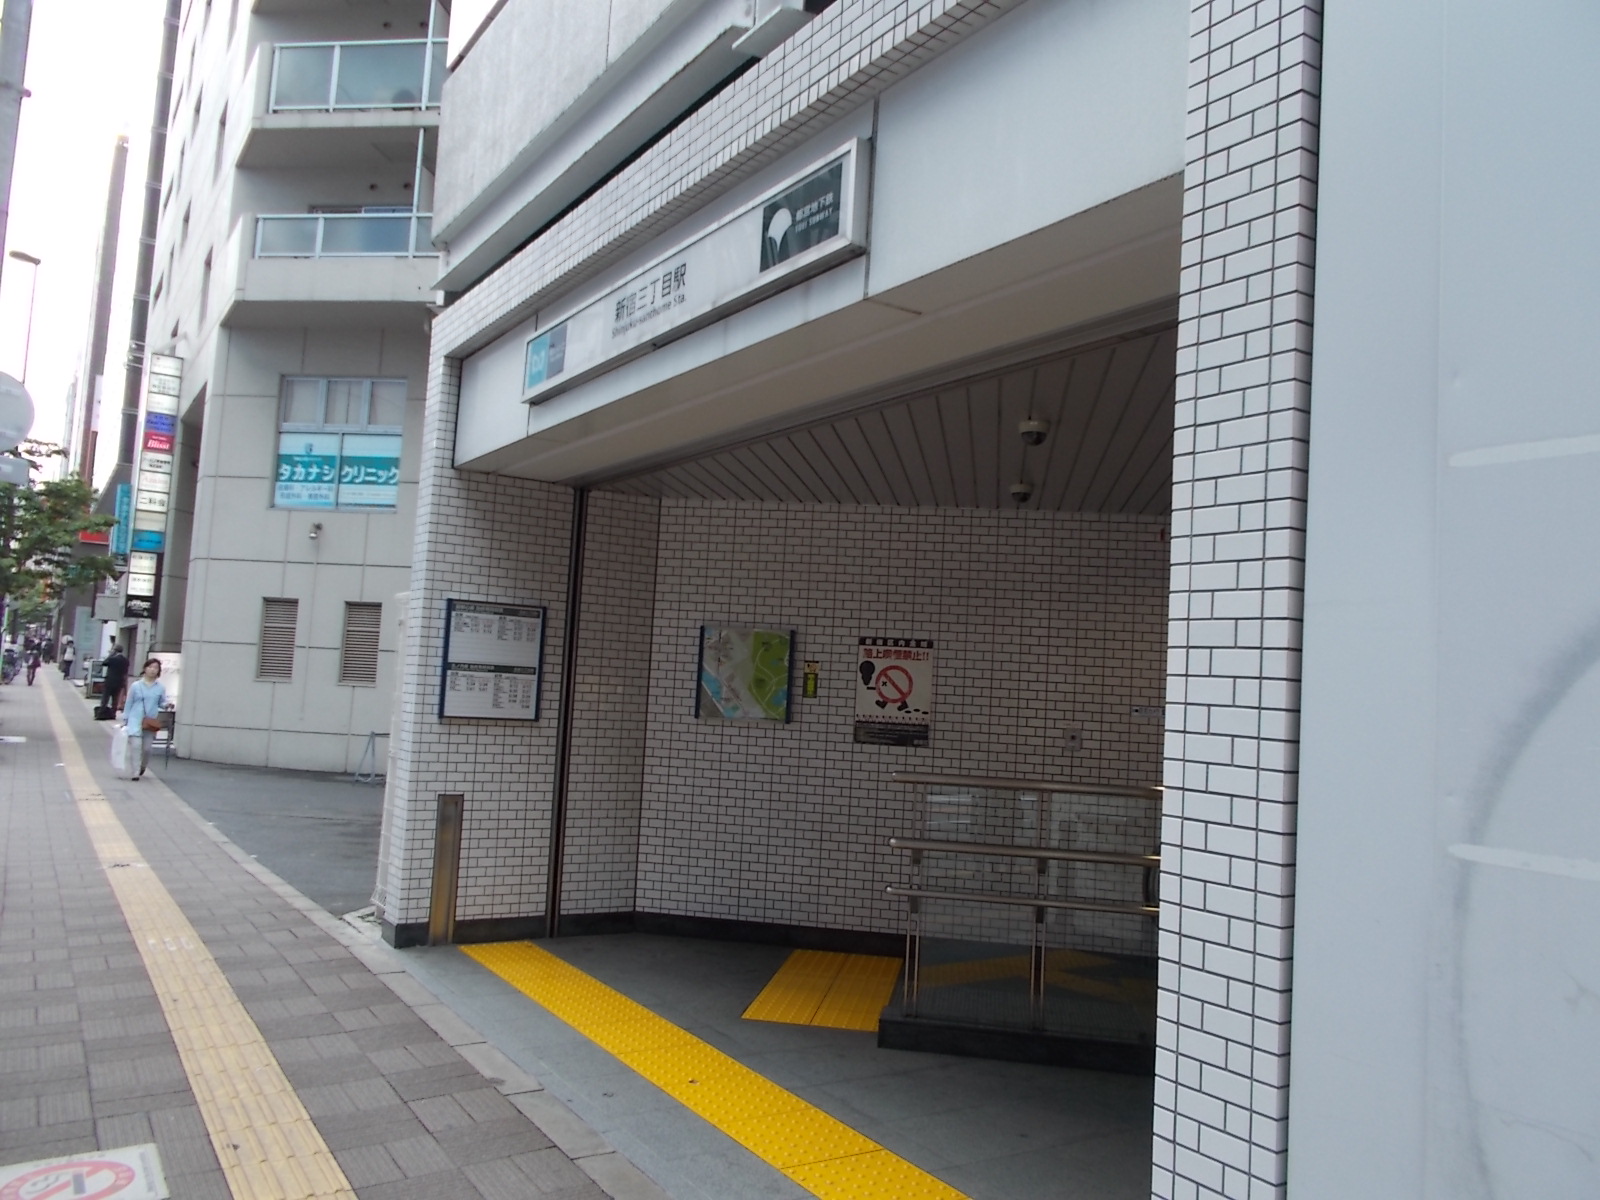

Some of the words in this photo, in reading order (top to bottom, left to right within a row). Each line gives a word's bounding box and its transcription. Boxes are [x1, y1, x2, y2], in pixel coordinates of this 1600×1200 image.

[614, 262, 687, 322] 新宿三丁目駅
[278, 464, 334, 481] タカナシ
[341, 465, 399, 484] クリニック
